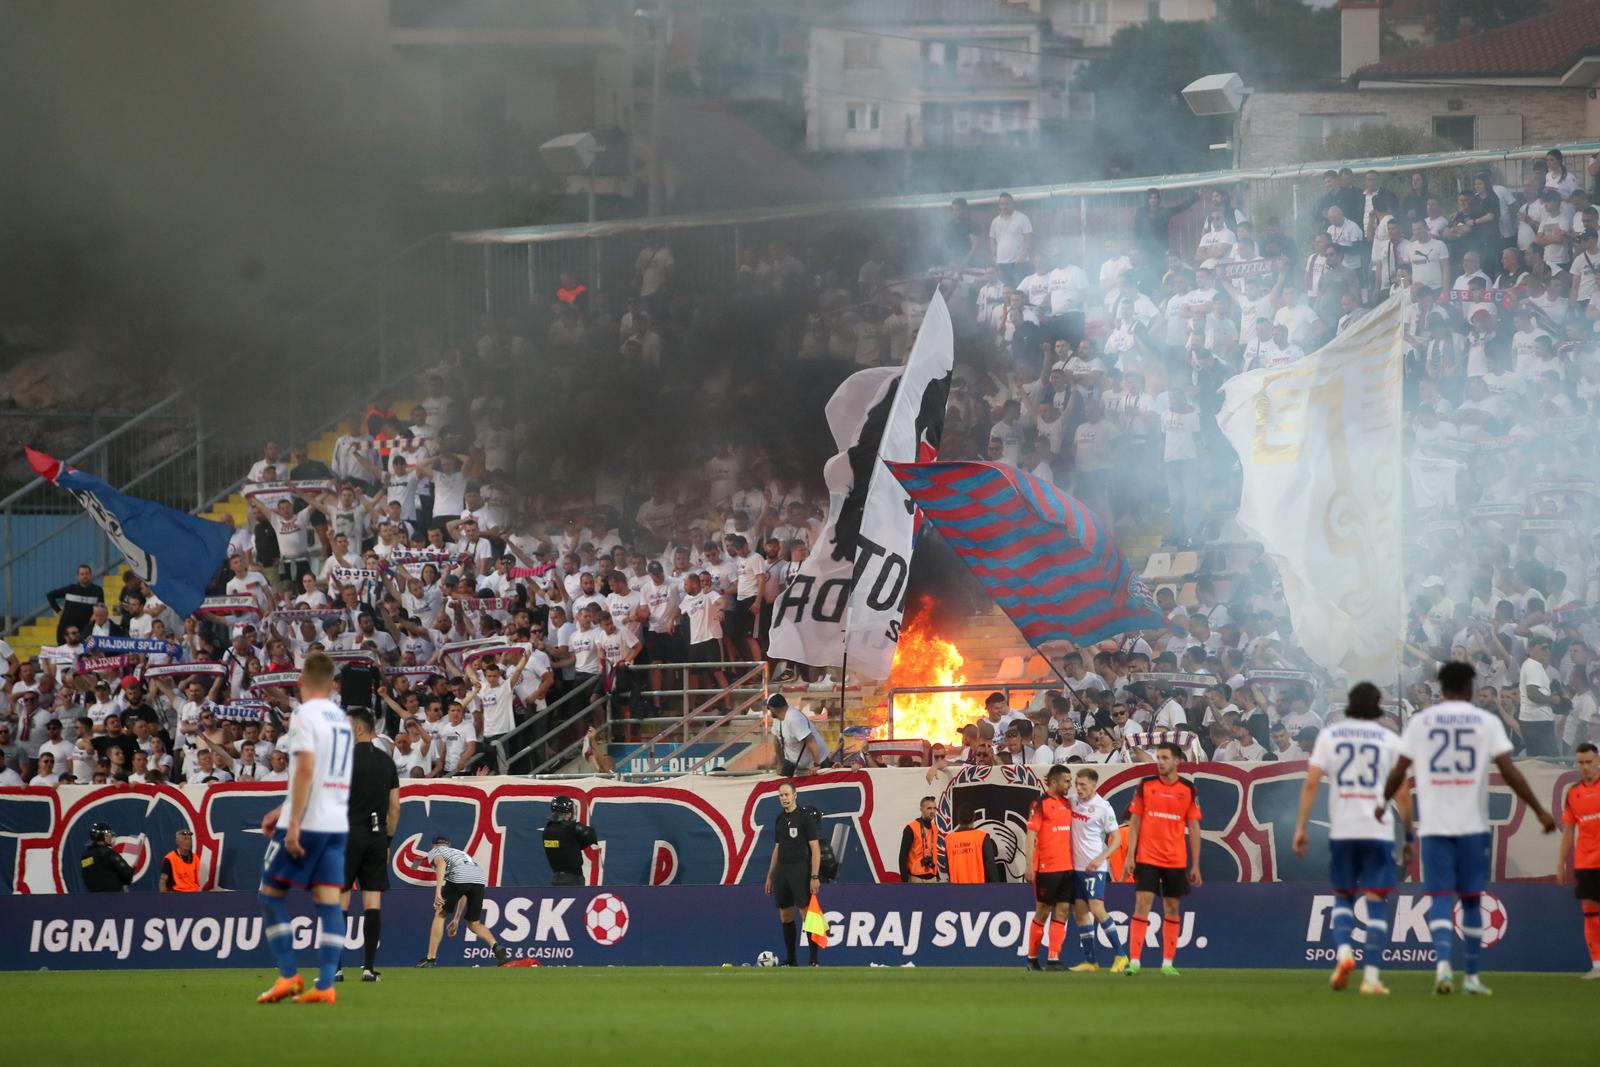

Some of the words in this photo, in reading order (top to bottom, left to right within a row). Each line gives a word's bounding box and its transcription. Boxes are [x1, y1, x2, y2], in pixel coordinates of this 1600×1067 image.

[850, 533, 908, 613] TO
[84, 656, 120, 669] HAJDUK
[98, 638, 135, 649] HAJDUK
[137, 641, 164, 650] SPLIT
[213, 706, 259, 718] AJDUK
[329, 727, 351, 776] 17
[1335, 743, 1380, 787] 23
[1429, 728, 1475, 773] 25
[30, 918, 134, 960] IGRAJ
[141, 917, 263, 959] SVOJU
[463, 947, 512, 959] SPORS
[515, 948, 523, 959] &
[527, 947, 574, 959] CASINO
